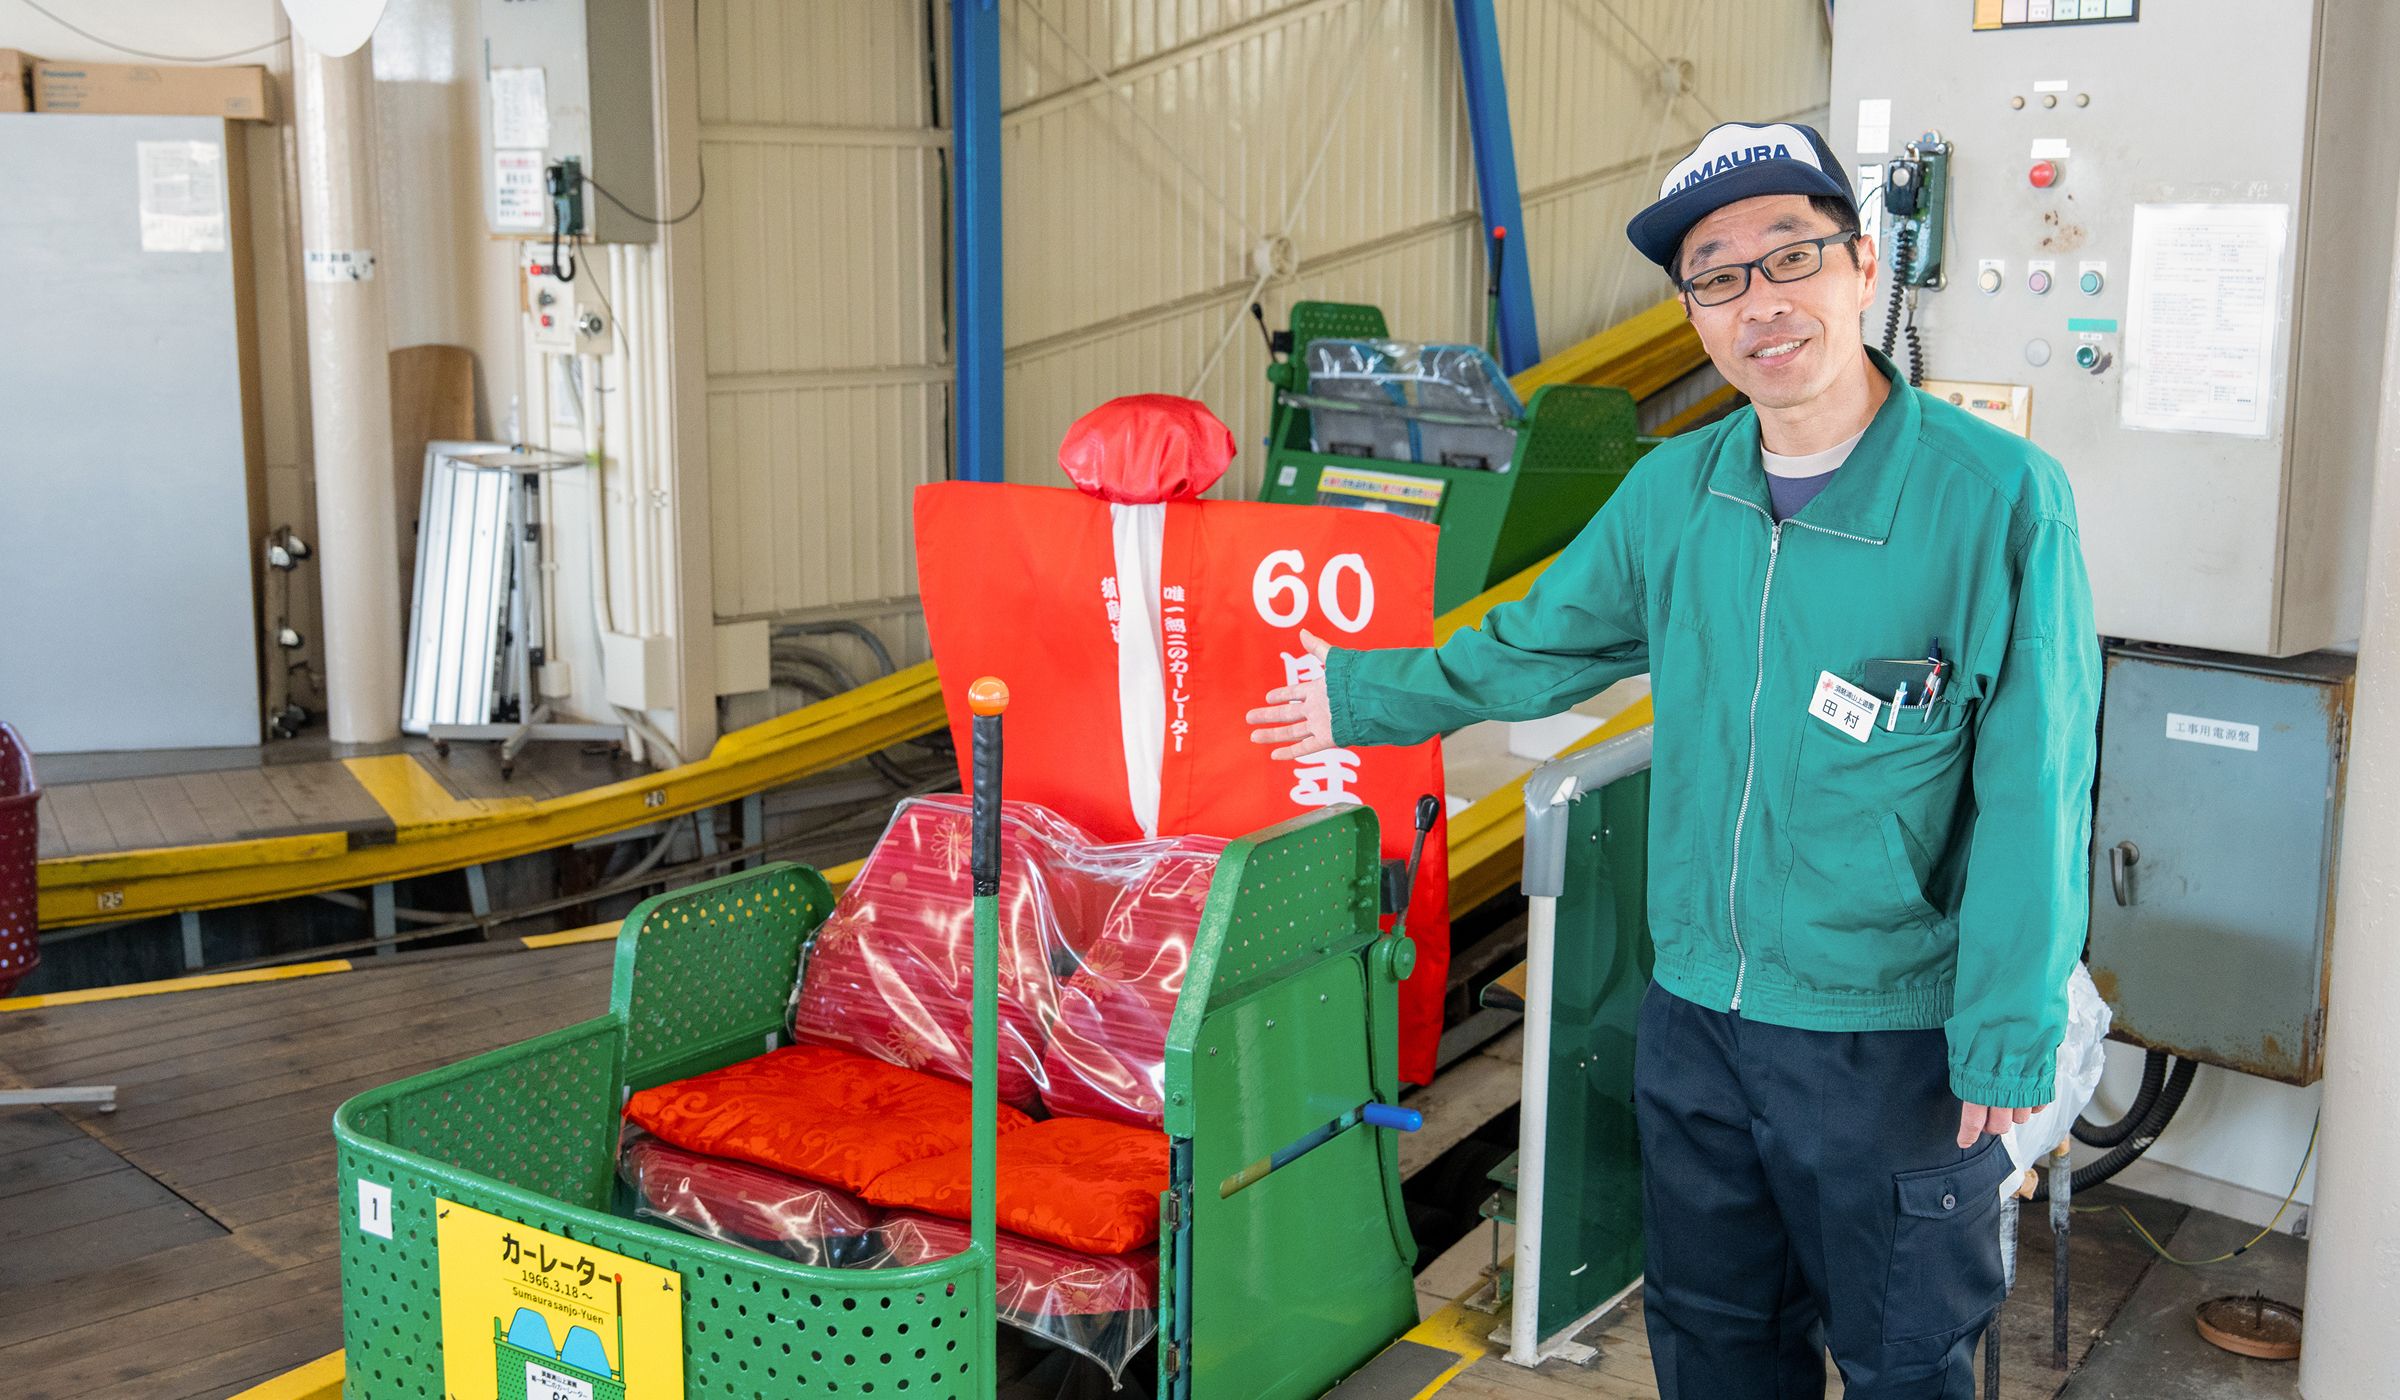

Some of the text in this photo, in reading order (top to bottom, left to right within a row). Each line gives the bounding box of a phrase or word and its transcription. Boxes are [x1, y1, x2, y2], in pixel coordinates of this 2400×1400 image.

[1252, 549, 1375, 633] 60
[1163, 585, 1190, 752] 唯一無二のカーレーター
[372, 1197, 378, 1221] 1
[502, 1233, 612, 1287] カーレーター
